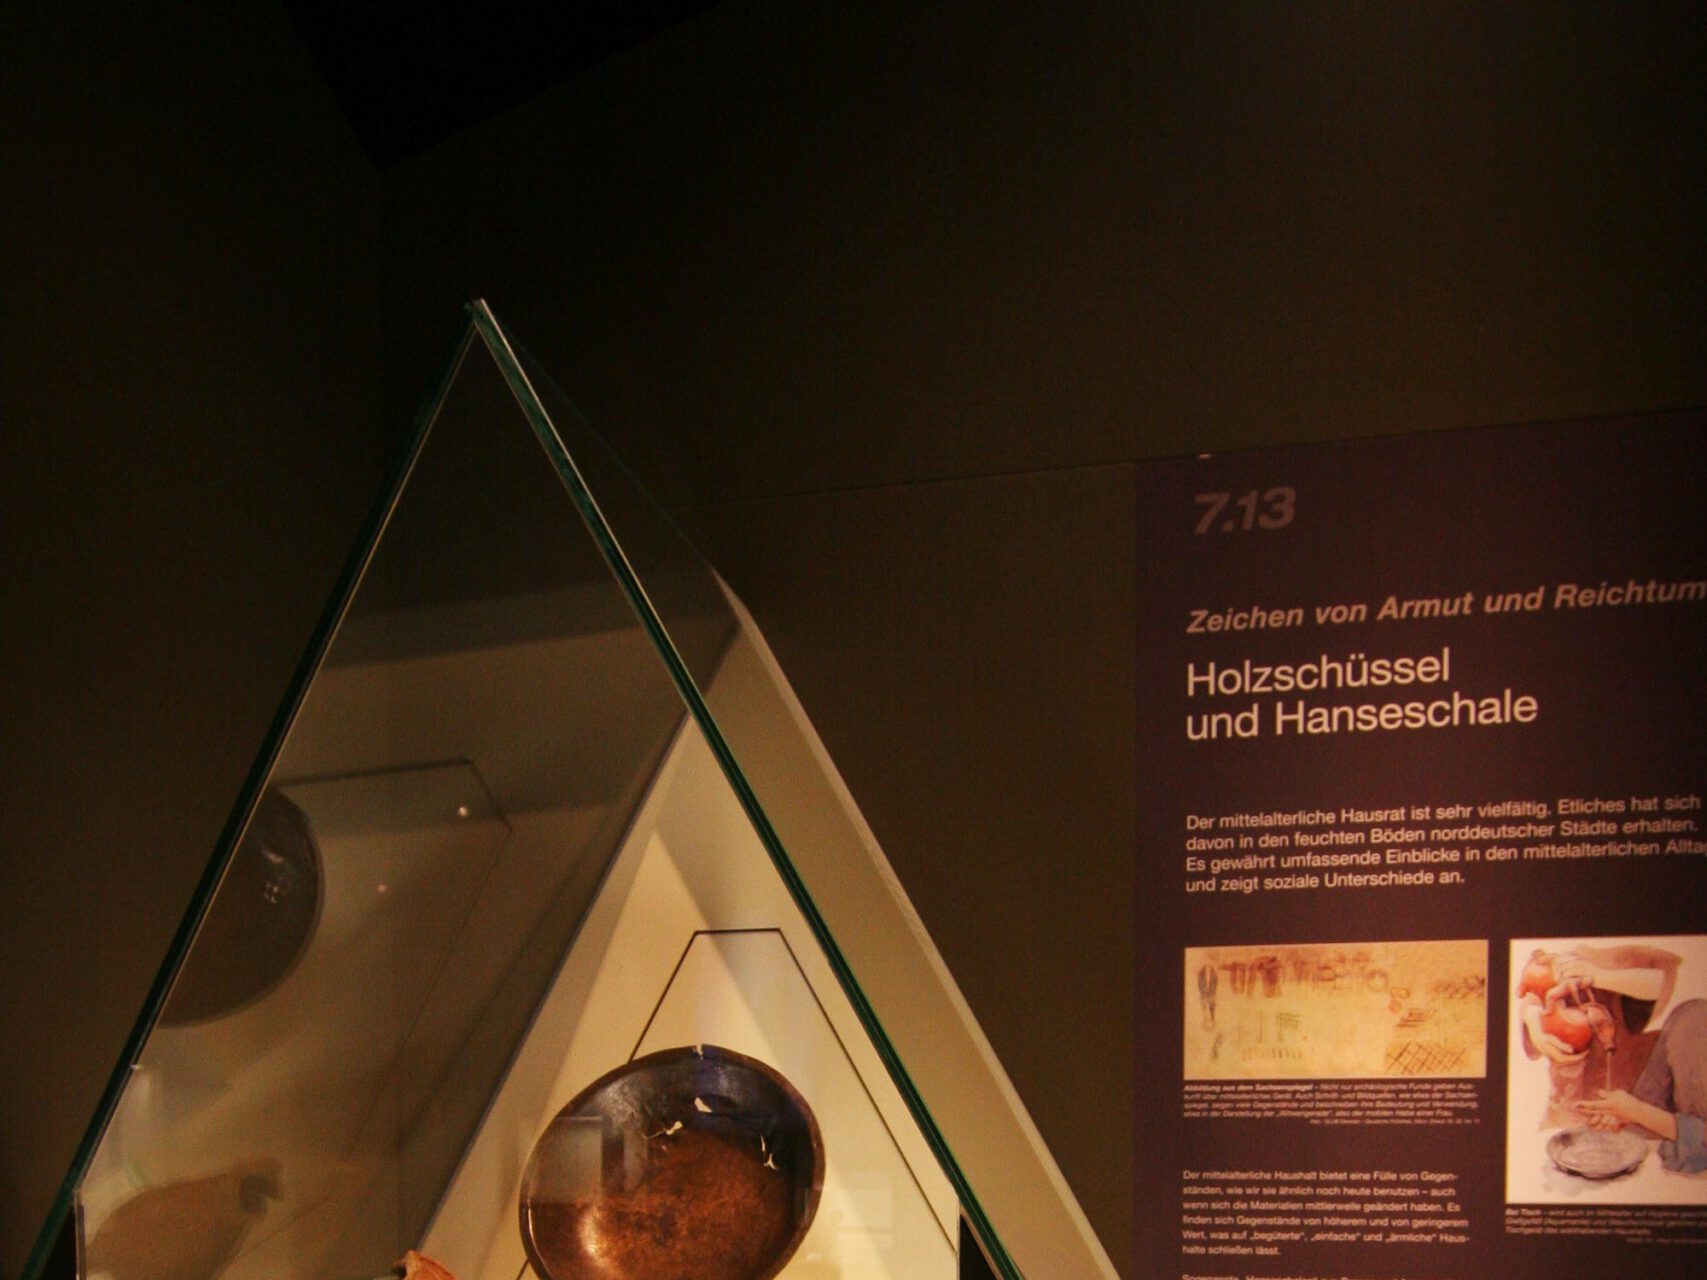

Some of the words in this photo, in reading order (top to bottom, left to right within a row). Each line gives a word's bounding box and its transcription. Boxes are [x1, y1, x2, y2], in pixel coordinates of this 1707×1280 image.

[1193, 486, 1296, 535] 7.13
[1187, 606, 1303, 633] Zeichen
[1315, 604, 1366, 624] von
[1377, 593, 1473, 620] Armut
[1484, 587, 1544, 613] und
[1554, 581, 1707, 608] Reichtum
[1187, 647, 1451, 697] Holzschüssel
[1187, 702, 1259, 741] und
[1274, 689, 1538, 736] Hanseschale
[1187, 815, 1214, 829] Der
[1219, 811, 1335, 827] mittelalterliche
[1340, 808, 1405, 822] Hausrat
[1410, 806, 1430, 820] ist
[1435, 805, 1472, 819] sehr
[1477, 801, 1552, 819] vielfältig.
[1557, 799, 1625, 814] Etliches
[1630, 797, 1658, 811] hat
[1663, 796, 1700, 810] sich
[1187, 836, 1234, 850] davon
[1239, 835, 1253, 848] in
[1258, 834, 1289, 847] den
[1294, 831, 1364, 846] feuchten
[1370, 828, 1425, 843] Böden
[1430, 825, 1554, 840] norddeutscher
[1559, 821, 1617, 836] Städte
[1622, 819, 1697, 833] erhalten.
[1187, 857, 1205, 871] Es
[1210, 855, 1275, 873] gewährt
[1280, 852, 1380, 867] umfassende
[1385, 848, 1460, 864] Einblicke
[1464, 847, 1480, 861] in
[1484, 846, 1517, 860] den
[1523, 843, 1659, 858] mittelalterlichen
[1664, 838, 1707, 858] Allta
[1187, 878, 1215, 892] und
[1220, 877, 1258, 893] zeigt
[1263, 875, 1319, 889] soziale
[1324, 871, 1434, 887] Unterschiede
[1438, 872, 1464, 883] an.
